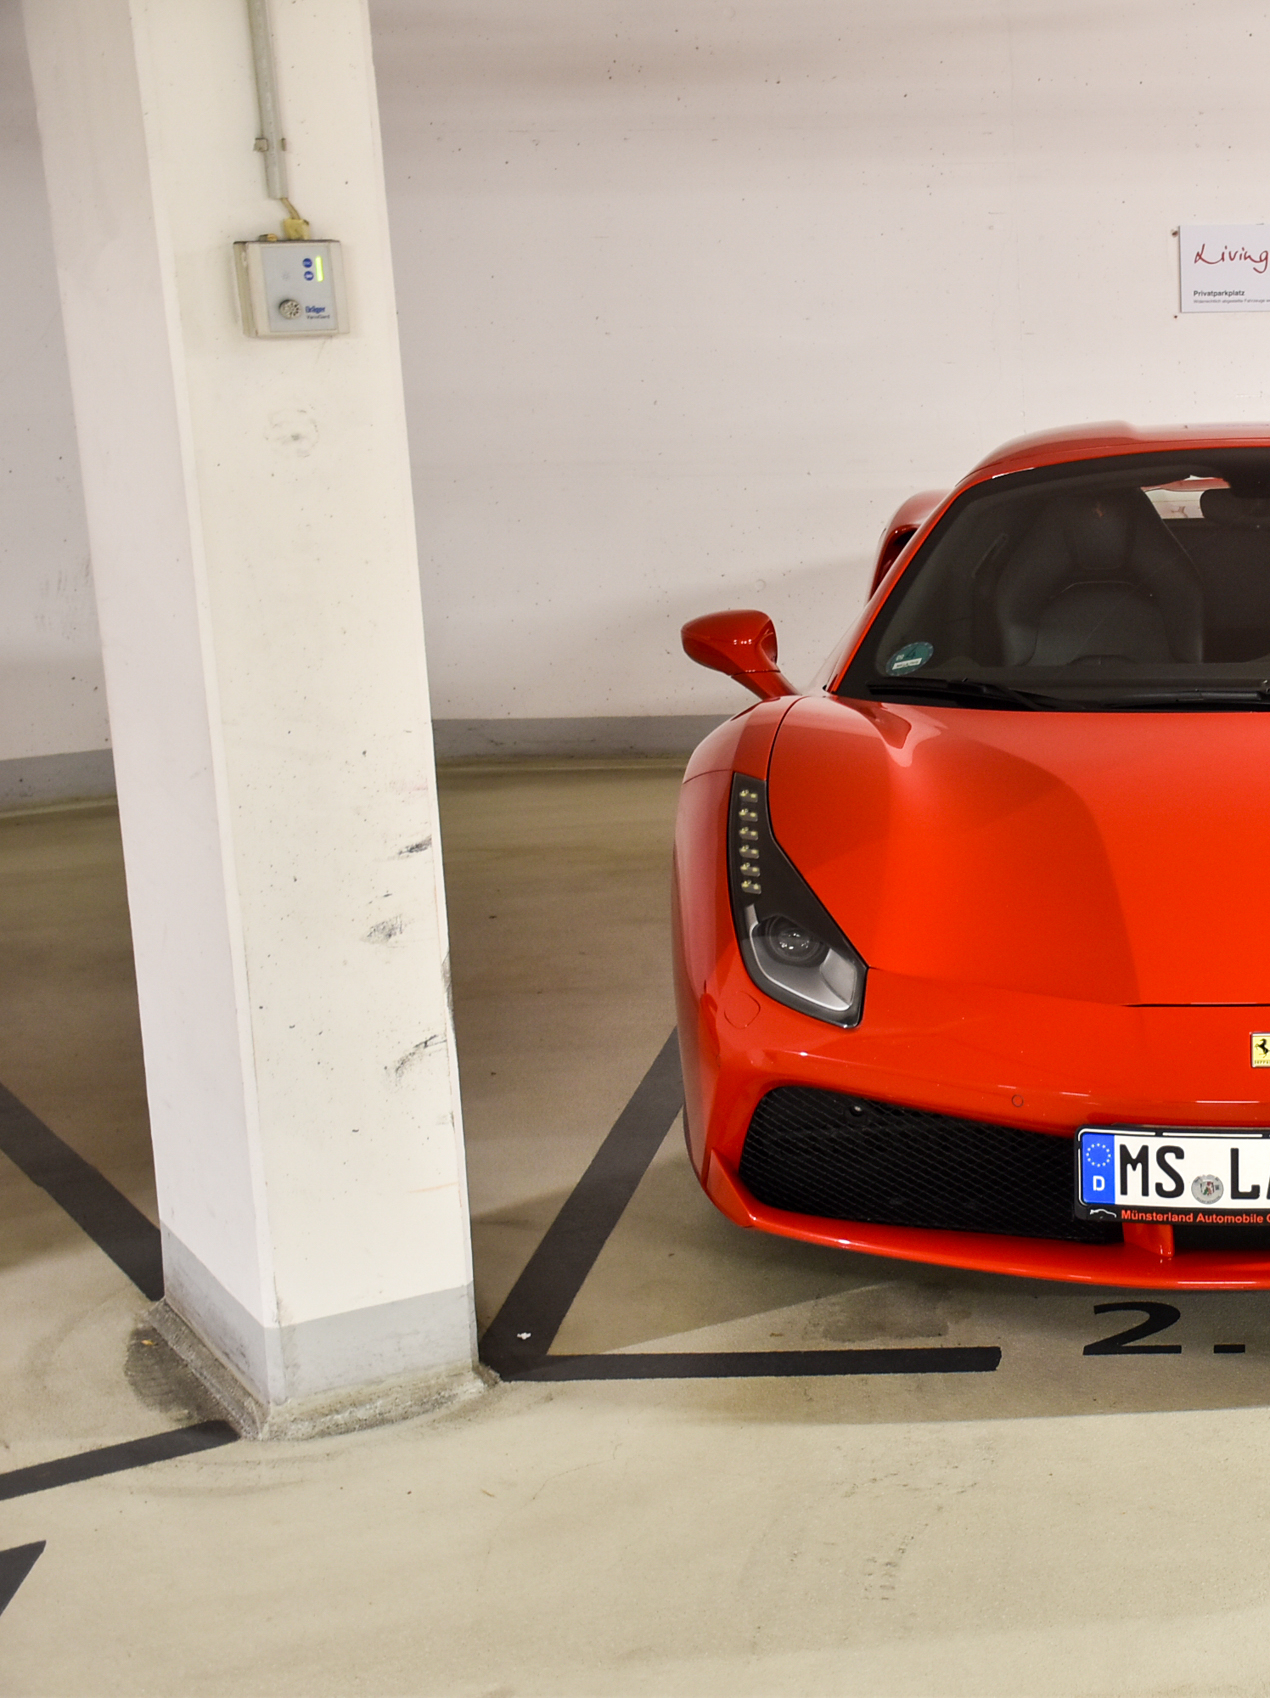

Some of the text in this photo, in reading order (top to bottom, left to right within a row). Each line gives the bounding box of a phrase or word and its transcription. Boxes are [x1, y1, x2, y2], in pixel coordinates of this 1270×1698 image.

[1119, 1144, 1185, 1199] MS
[1092, 1175, 1106, 1192] D
[1121, 1209, 1194, 1223] Münsterland
[1196, 1212, 1264, 1224] Automobile
